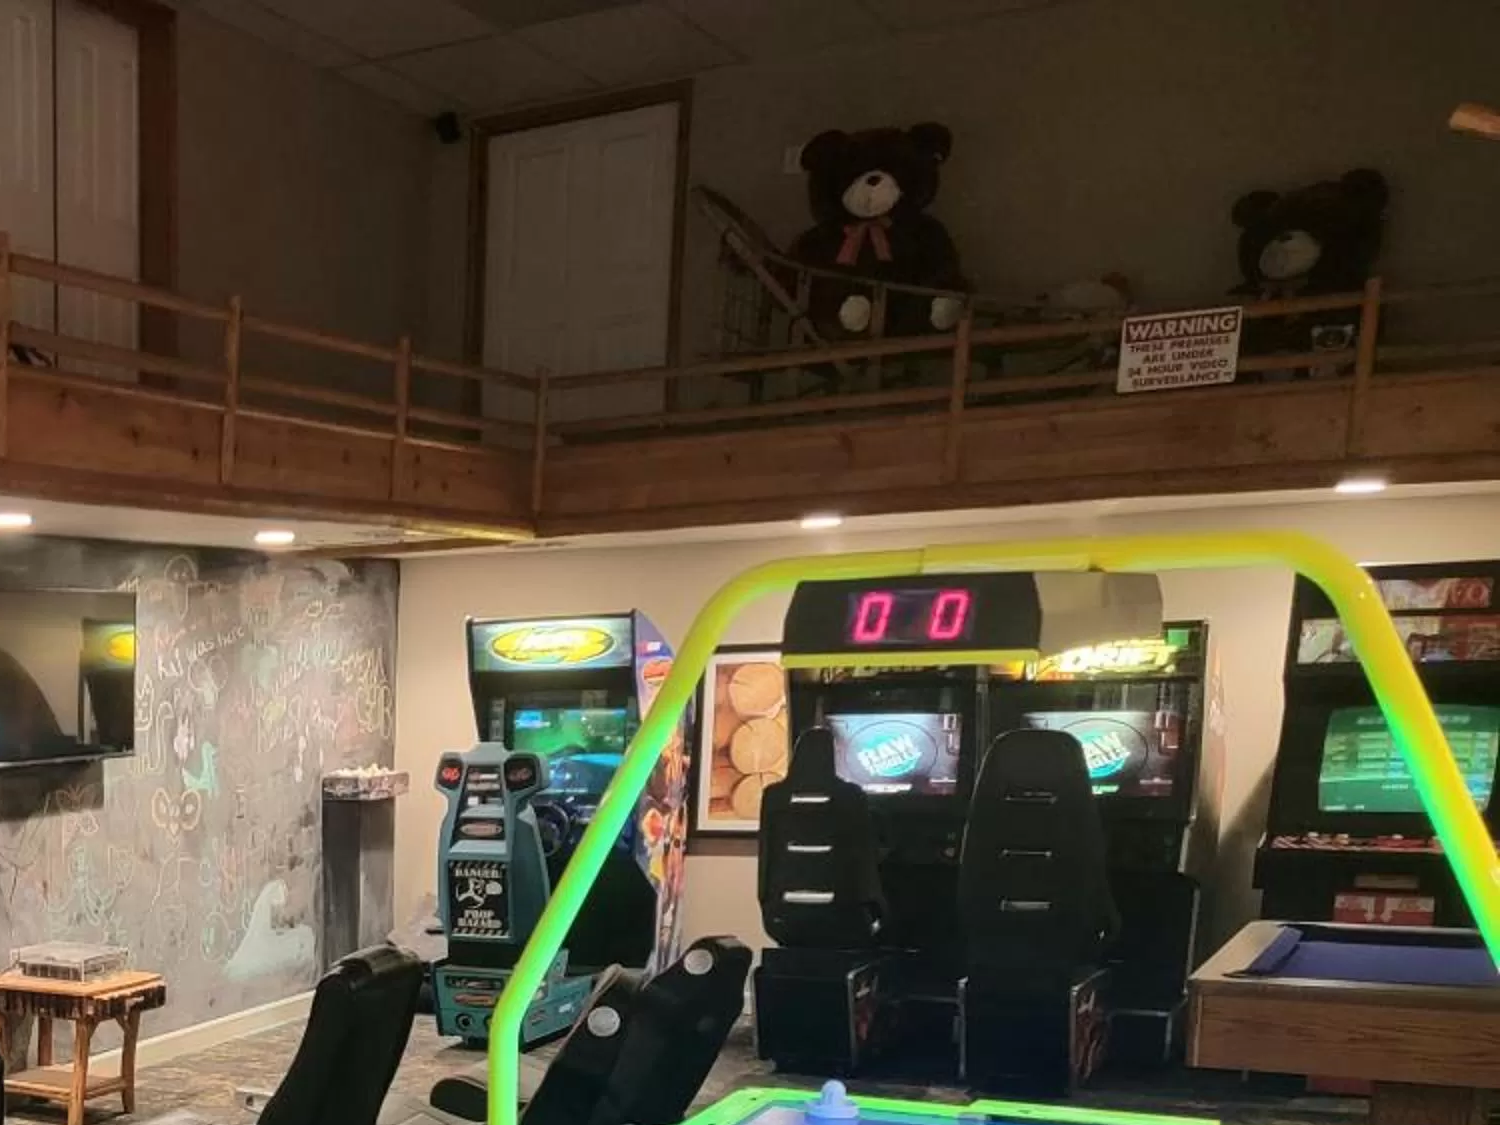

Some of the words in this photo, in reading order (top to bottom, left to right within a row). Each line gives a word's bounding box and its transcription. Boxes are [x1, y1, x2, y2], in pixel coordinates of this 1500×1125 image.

[1128, 313, 1237, 340] WARNING
[1128, 341, 1164, 354] THESE
[1170, 335, 1230, 350] PREMISES
[1142, 353, 1164, 365] ARE
[1171, 348, 1215, 361] UNDER
[1127, 367, 1142, 378] 24
[1147, 363, 1184, 376] HOUR
[1190, 359, 1229, 371] VIDEO
[852, 591, 895, 644] 0
[927, 588, 972, 641] 0
